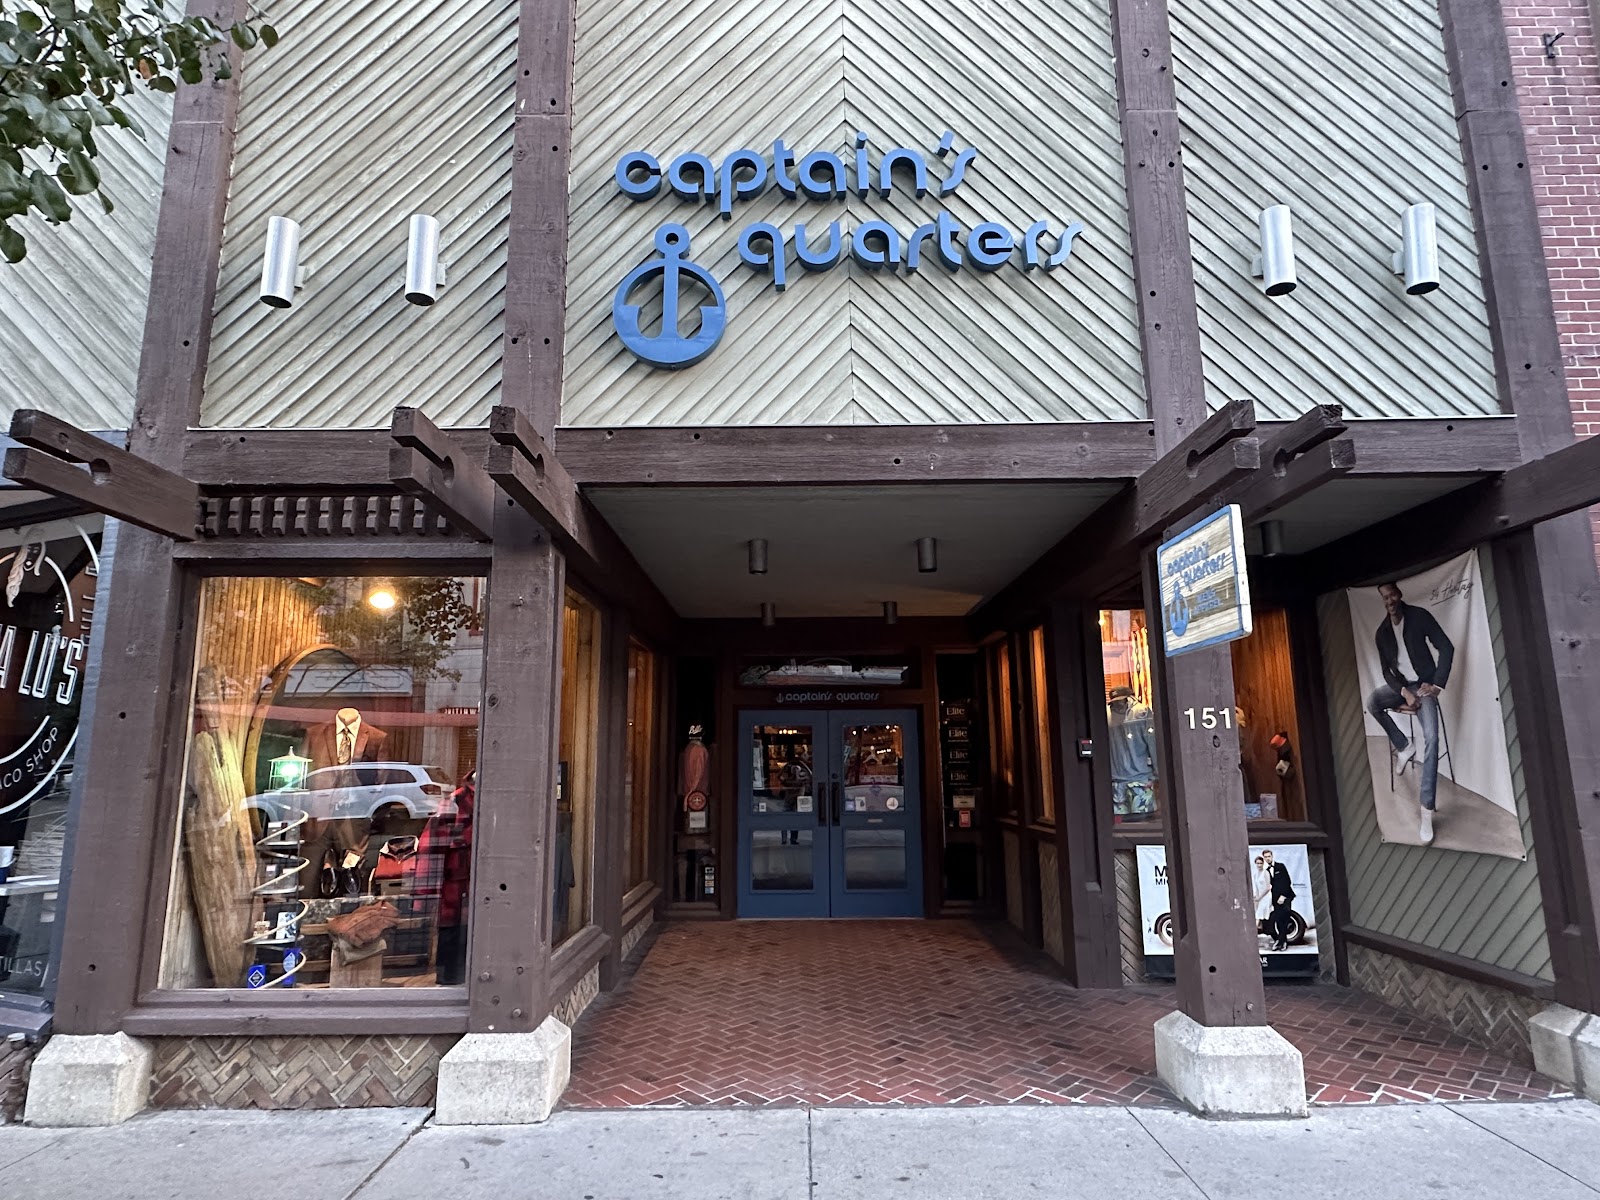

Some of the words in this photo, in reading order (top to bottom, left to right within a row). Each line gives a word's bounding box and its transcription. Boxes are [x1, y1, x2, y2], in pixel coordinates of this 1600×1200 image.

[615, 130, 977, 219] captain's
[737, 211, 1084, 291] quarters
[785, 691, 833, 703] captain's
[836, 691, 879, 703] quarters
[1184, 707, 1231, 729] 151
[26, 727, 58, 772] SHOP
